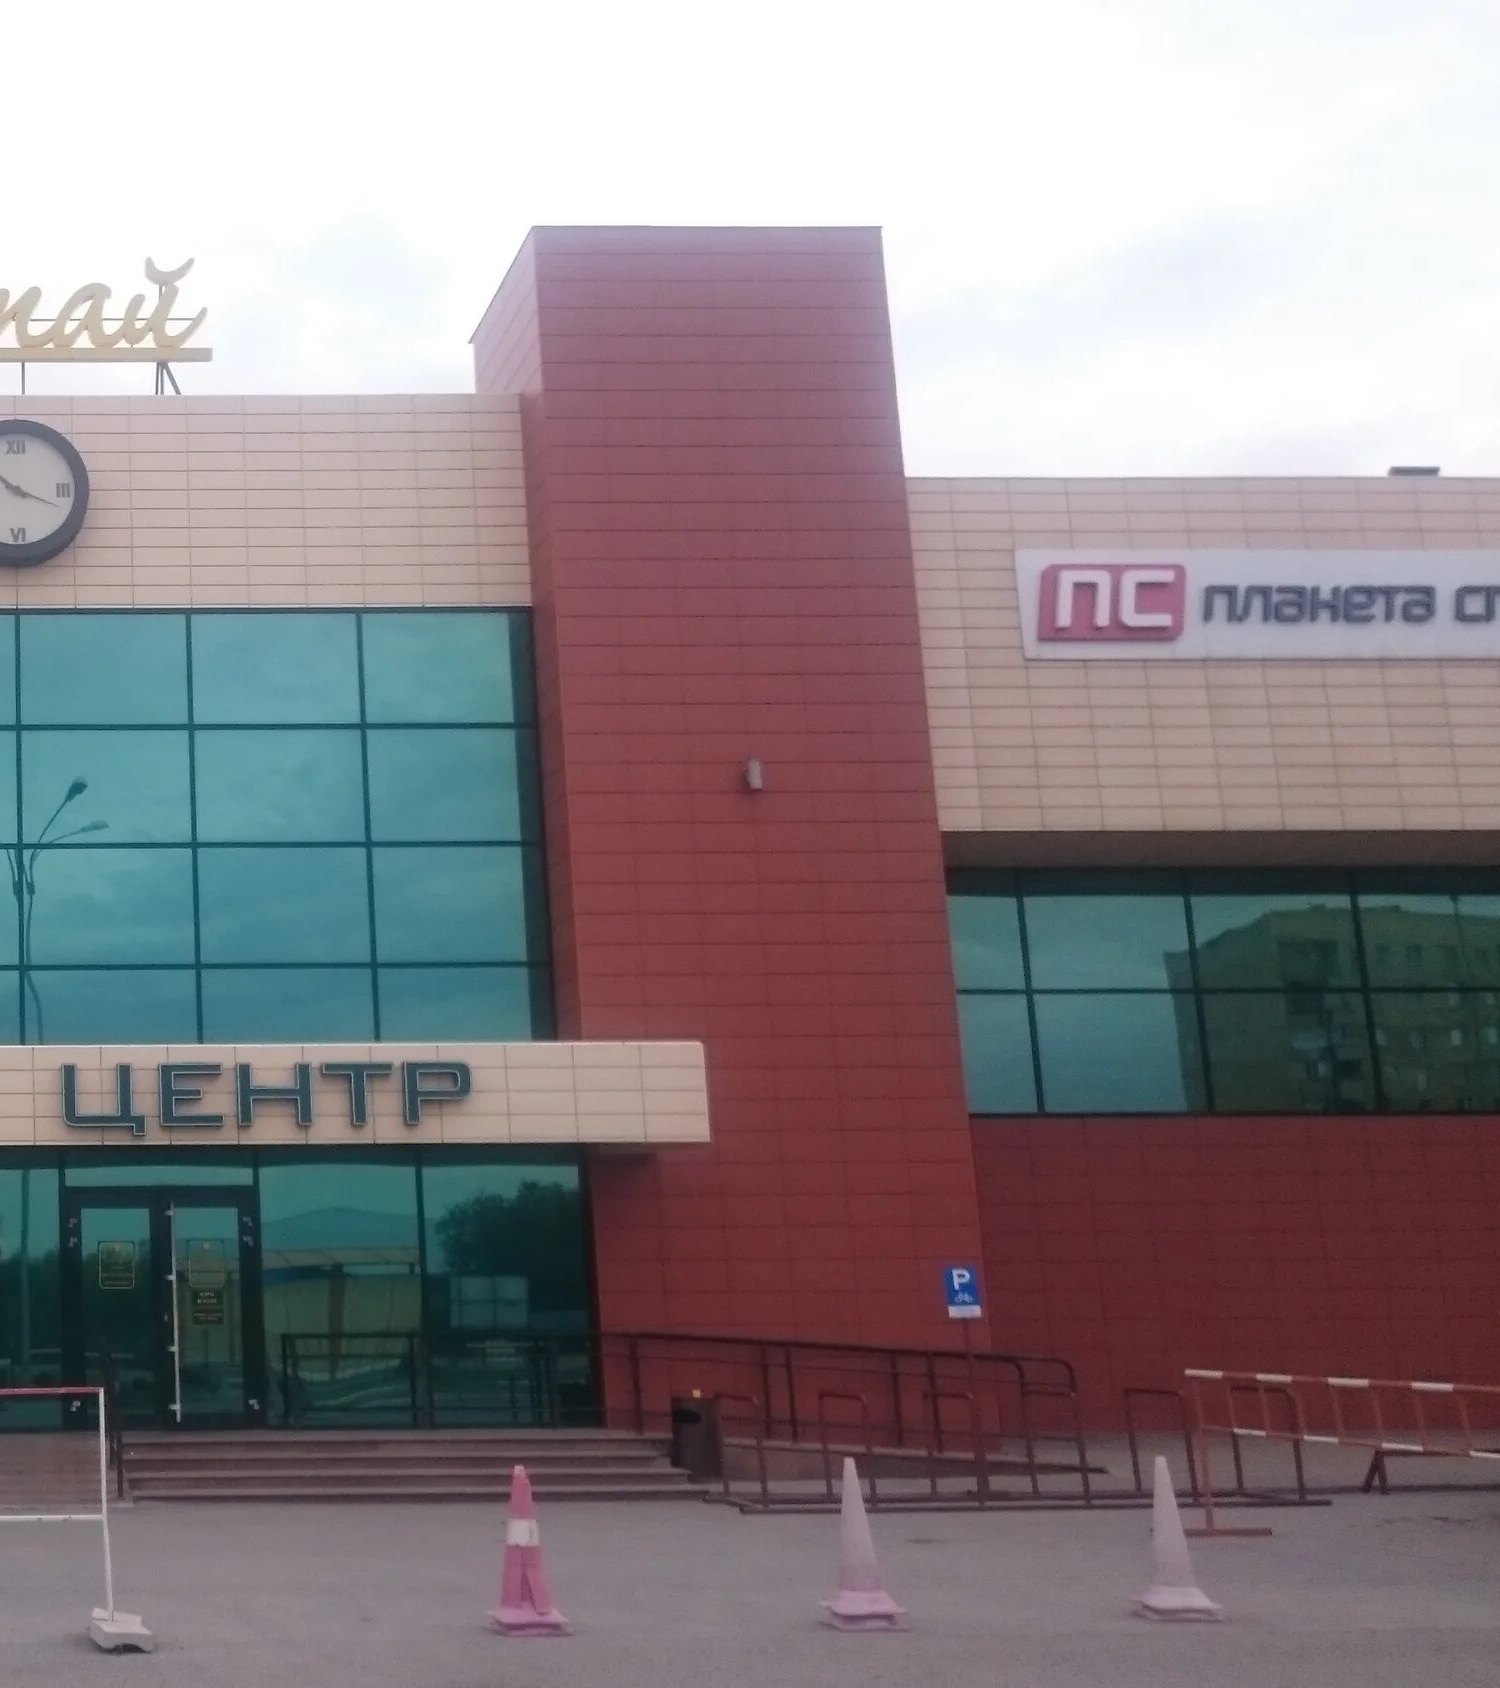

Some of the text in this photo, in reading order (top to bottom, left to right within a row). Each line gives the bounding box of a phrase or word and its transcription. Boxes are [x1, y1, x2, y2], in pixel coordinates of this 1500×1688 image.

[5, 440, 26, 455] XII
[55, 483, 71, 498] III
[9, 528, 26, 543] VI
[61, 1062, 472, 1136] ЦЕНТР
[952, 1268, 971, 1291] P
